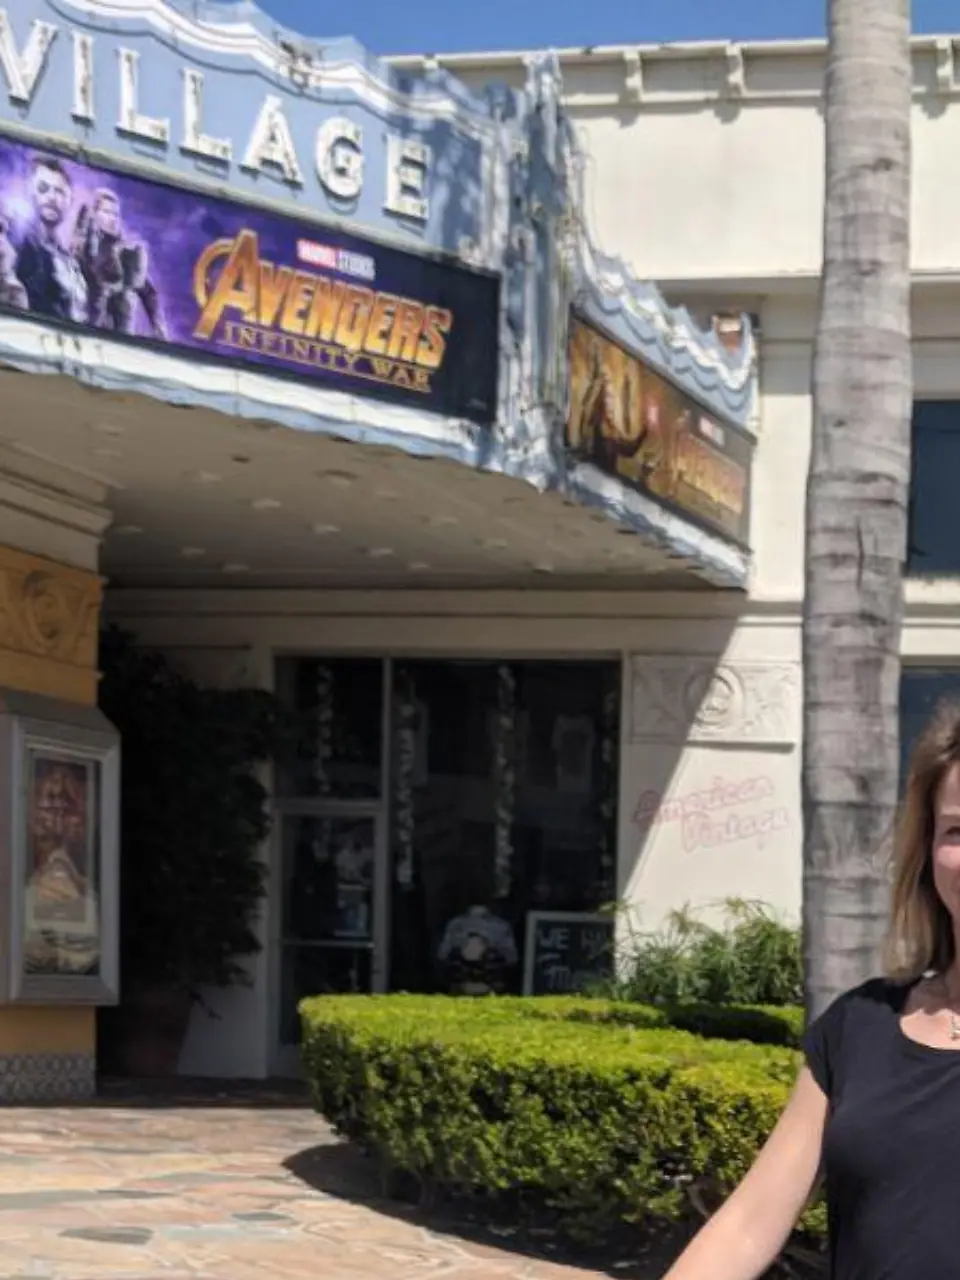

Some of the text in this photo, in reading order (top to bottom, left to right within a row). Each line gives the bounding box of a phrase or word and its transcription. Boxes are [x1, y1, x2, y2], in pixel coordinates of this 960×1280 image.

[0, 10, 431, 221] VILLAGE
[223, 321, 431, 393] INFINITY WAR
